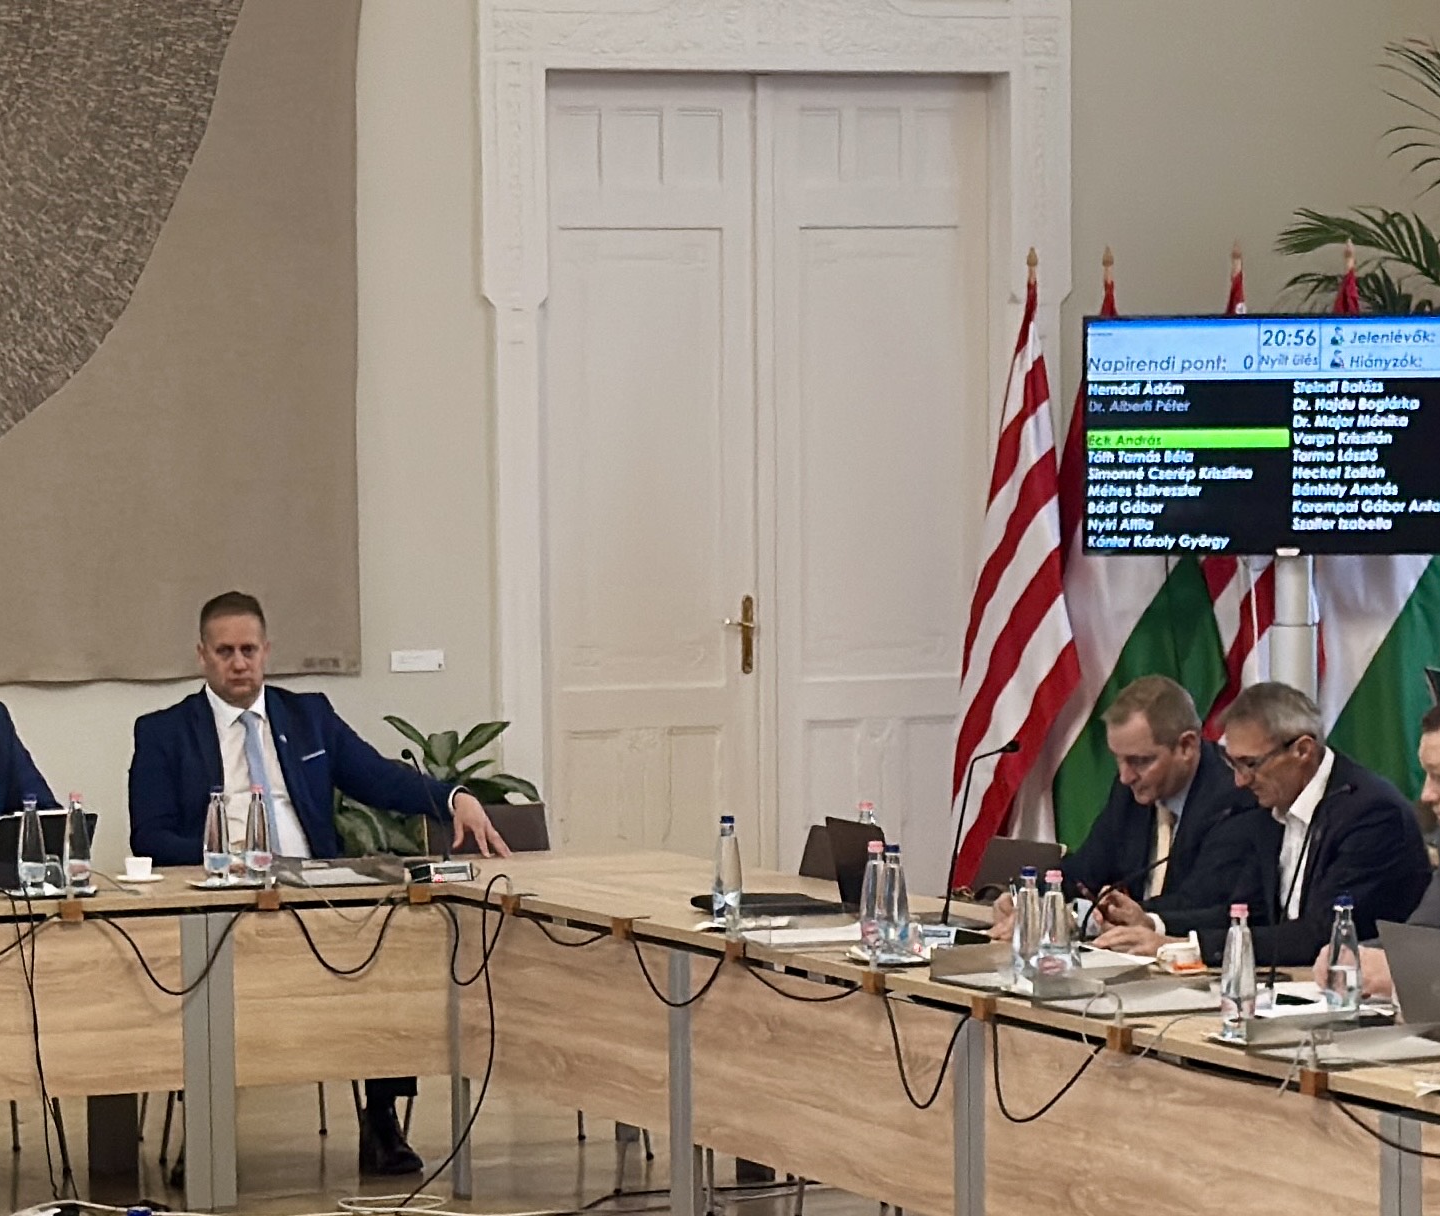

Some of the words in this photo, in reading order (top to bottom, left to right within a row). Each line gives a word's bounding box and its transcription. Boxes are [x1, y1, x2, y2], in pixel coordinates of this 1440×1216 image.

[1262, 329, 1317, 347] 20:56
[1088, 356, 1175, 373] Napirendi
[1181, 355, 1227, 374] pont:
[1243, 355, 1254, 370] 0
[1350, 354, 1423, 370] Hiányzók:
[1089, 400, 1105, 412] Dr.
[1155, 399, 1191, 412] Péter
[1293, 398, 1311, 411] Dr.
[1293, 415, 1311, 428] Dr.
[1314, 414, 1355, 431] Major
[1115, 434, 1162, 446] András
[1293, 432, 1335, 447] Varga
[1117, 450, 1161, 463] Tamás
[1337, 447, 1379, 462] László
[1344, 465, 1386, 479] Zoltán
[1350, 482, 1399, 496] András
[1120, 500, 1165, 514] Gábor
[1361, 499, 1406, 513] Gábor
[1133, 534, 1176, 550] Károly
[1178, 533, 1230, 550] György
